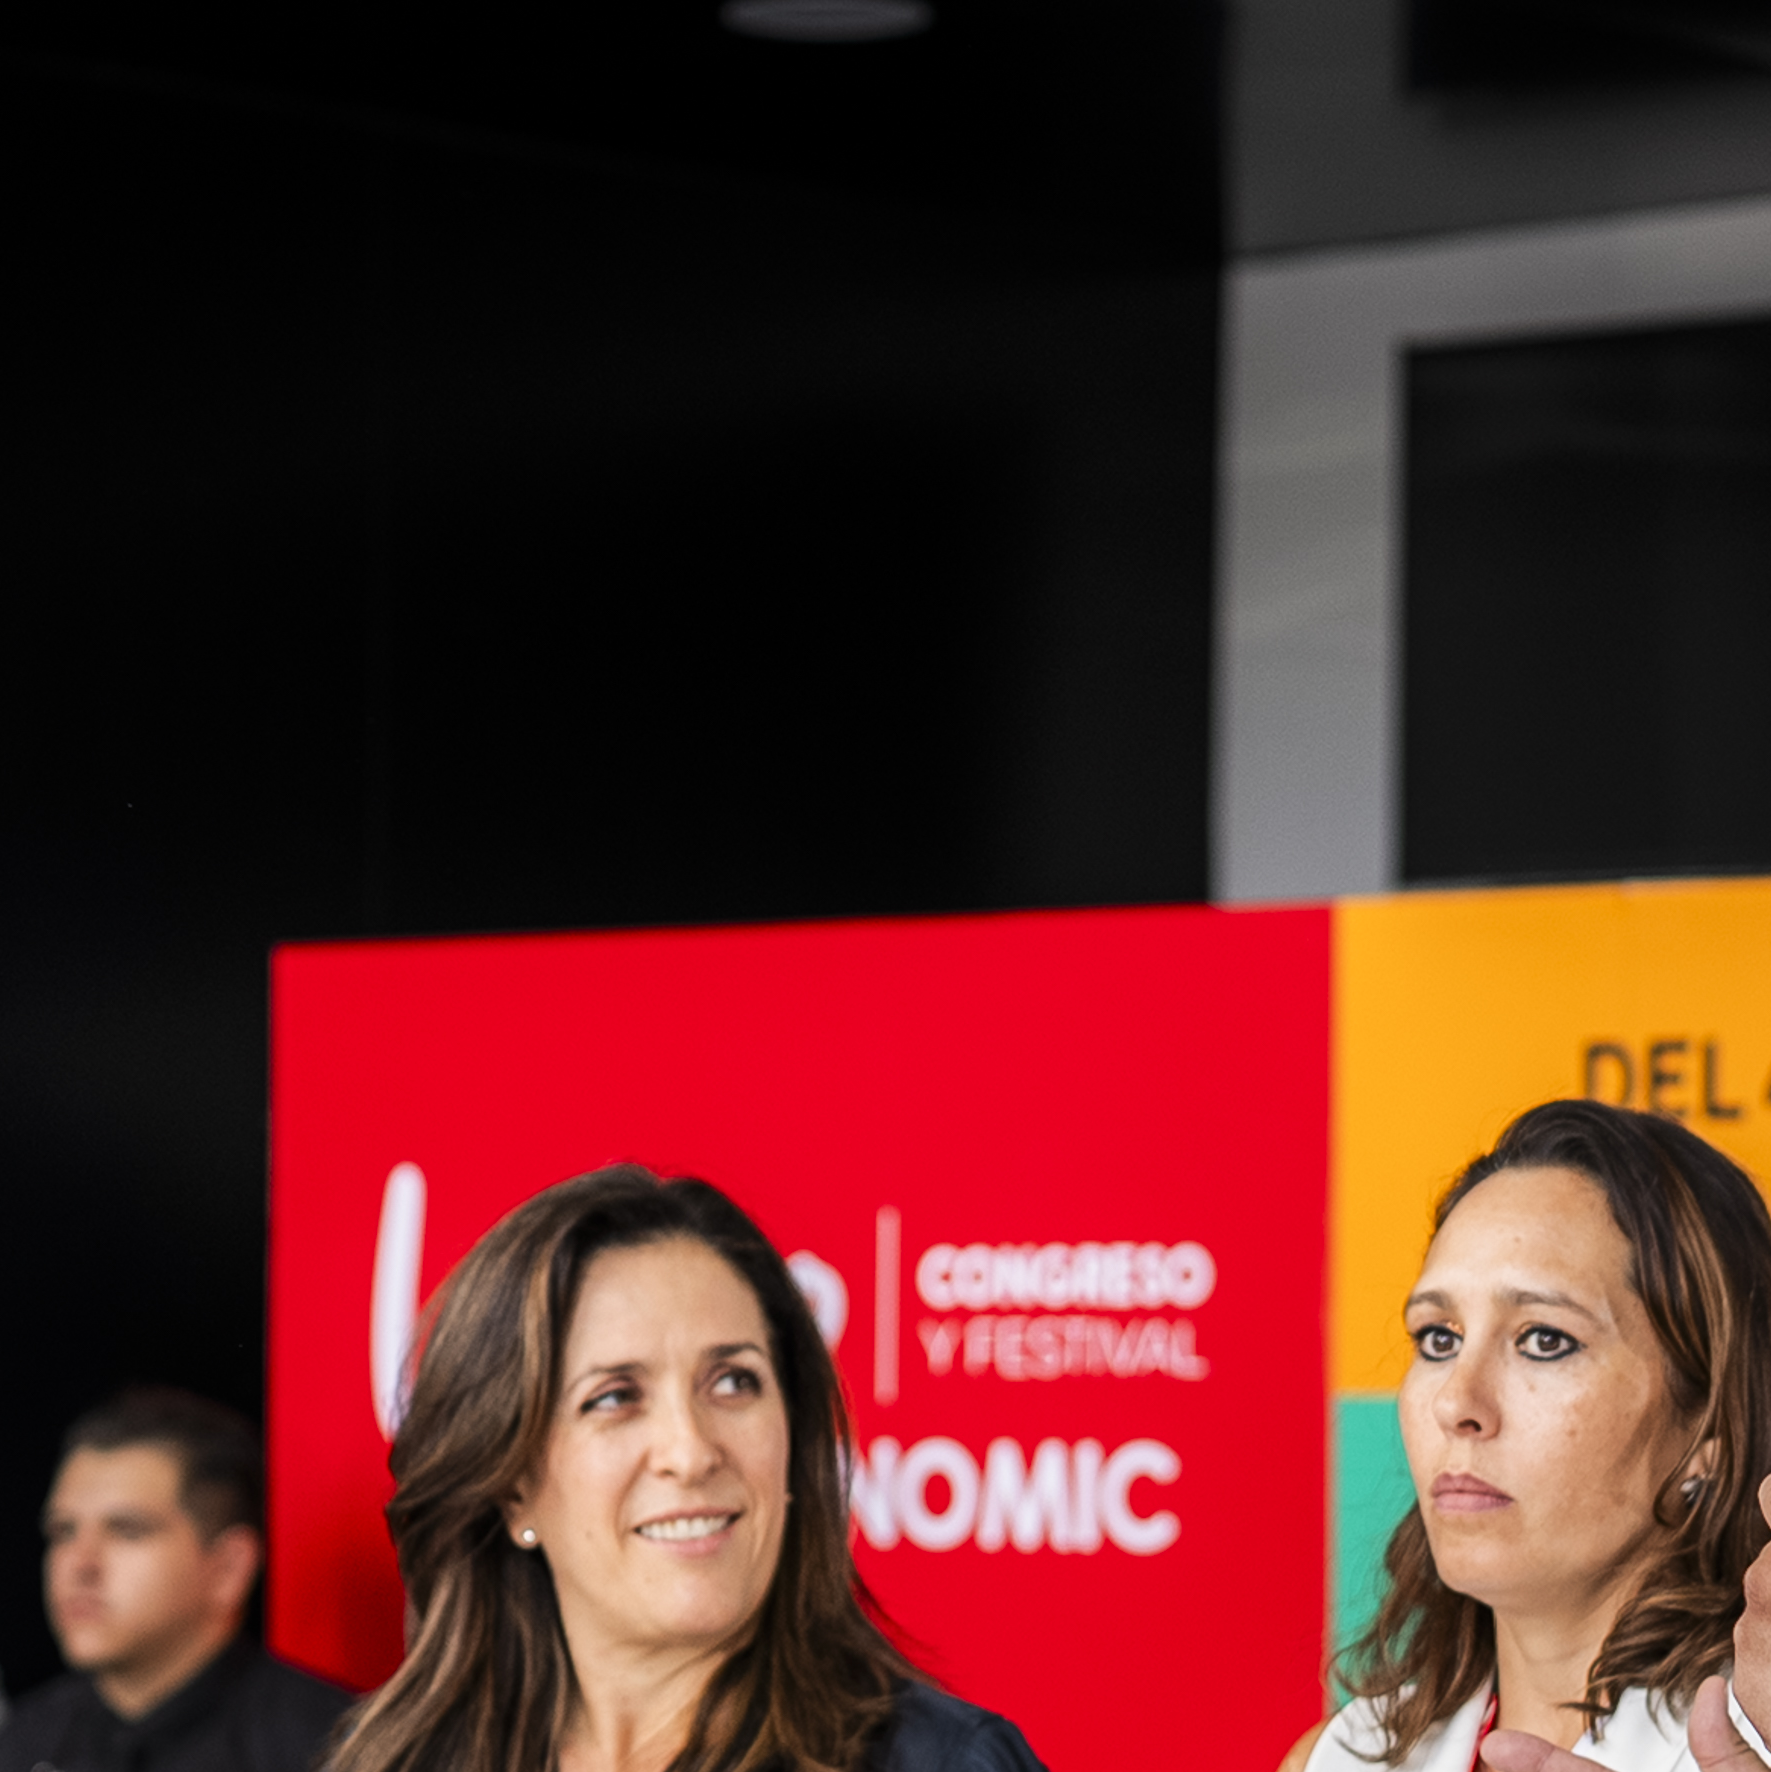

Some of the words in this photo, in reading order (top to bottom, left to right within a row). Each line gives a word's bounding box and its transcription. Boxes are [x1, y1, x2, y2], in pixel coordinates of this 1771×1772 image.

[1583, 1034, 1740, 1118] DEL
[915, 1242, 1217, 1310] CONGRESO
[916, 1317, 962, 1375] Y
[965, 1314, 1210, 1382] FESTIVAL
